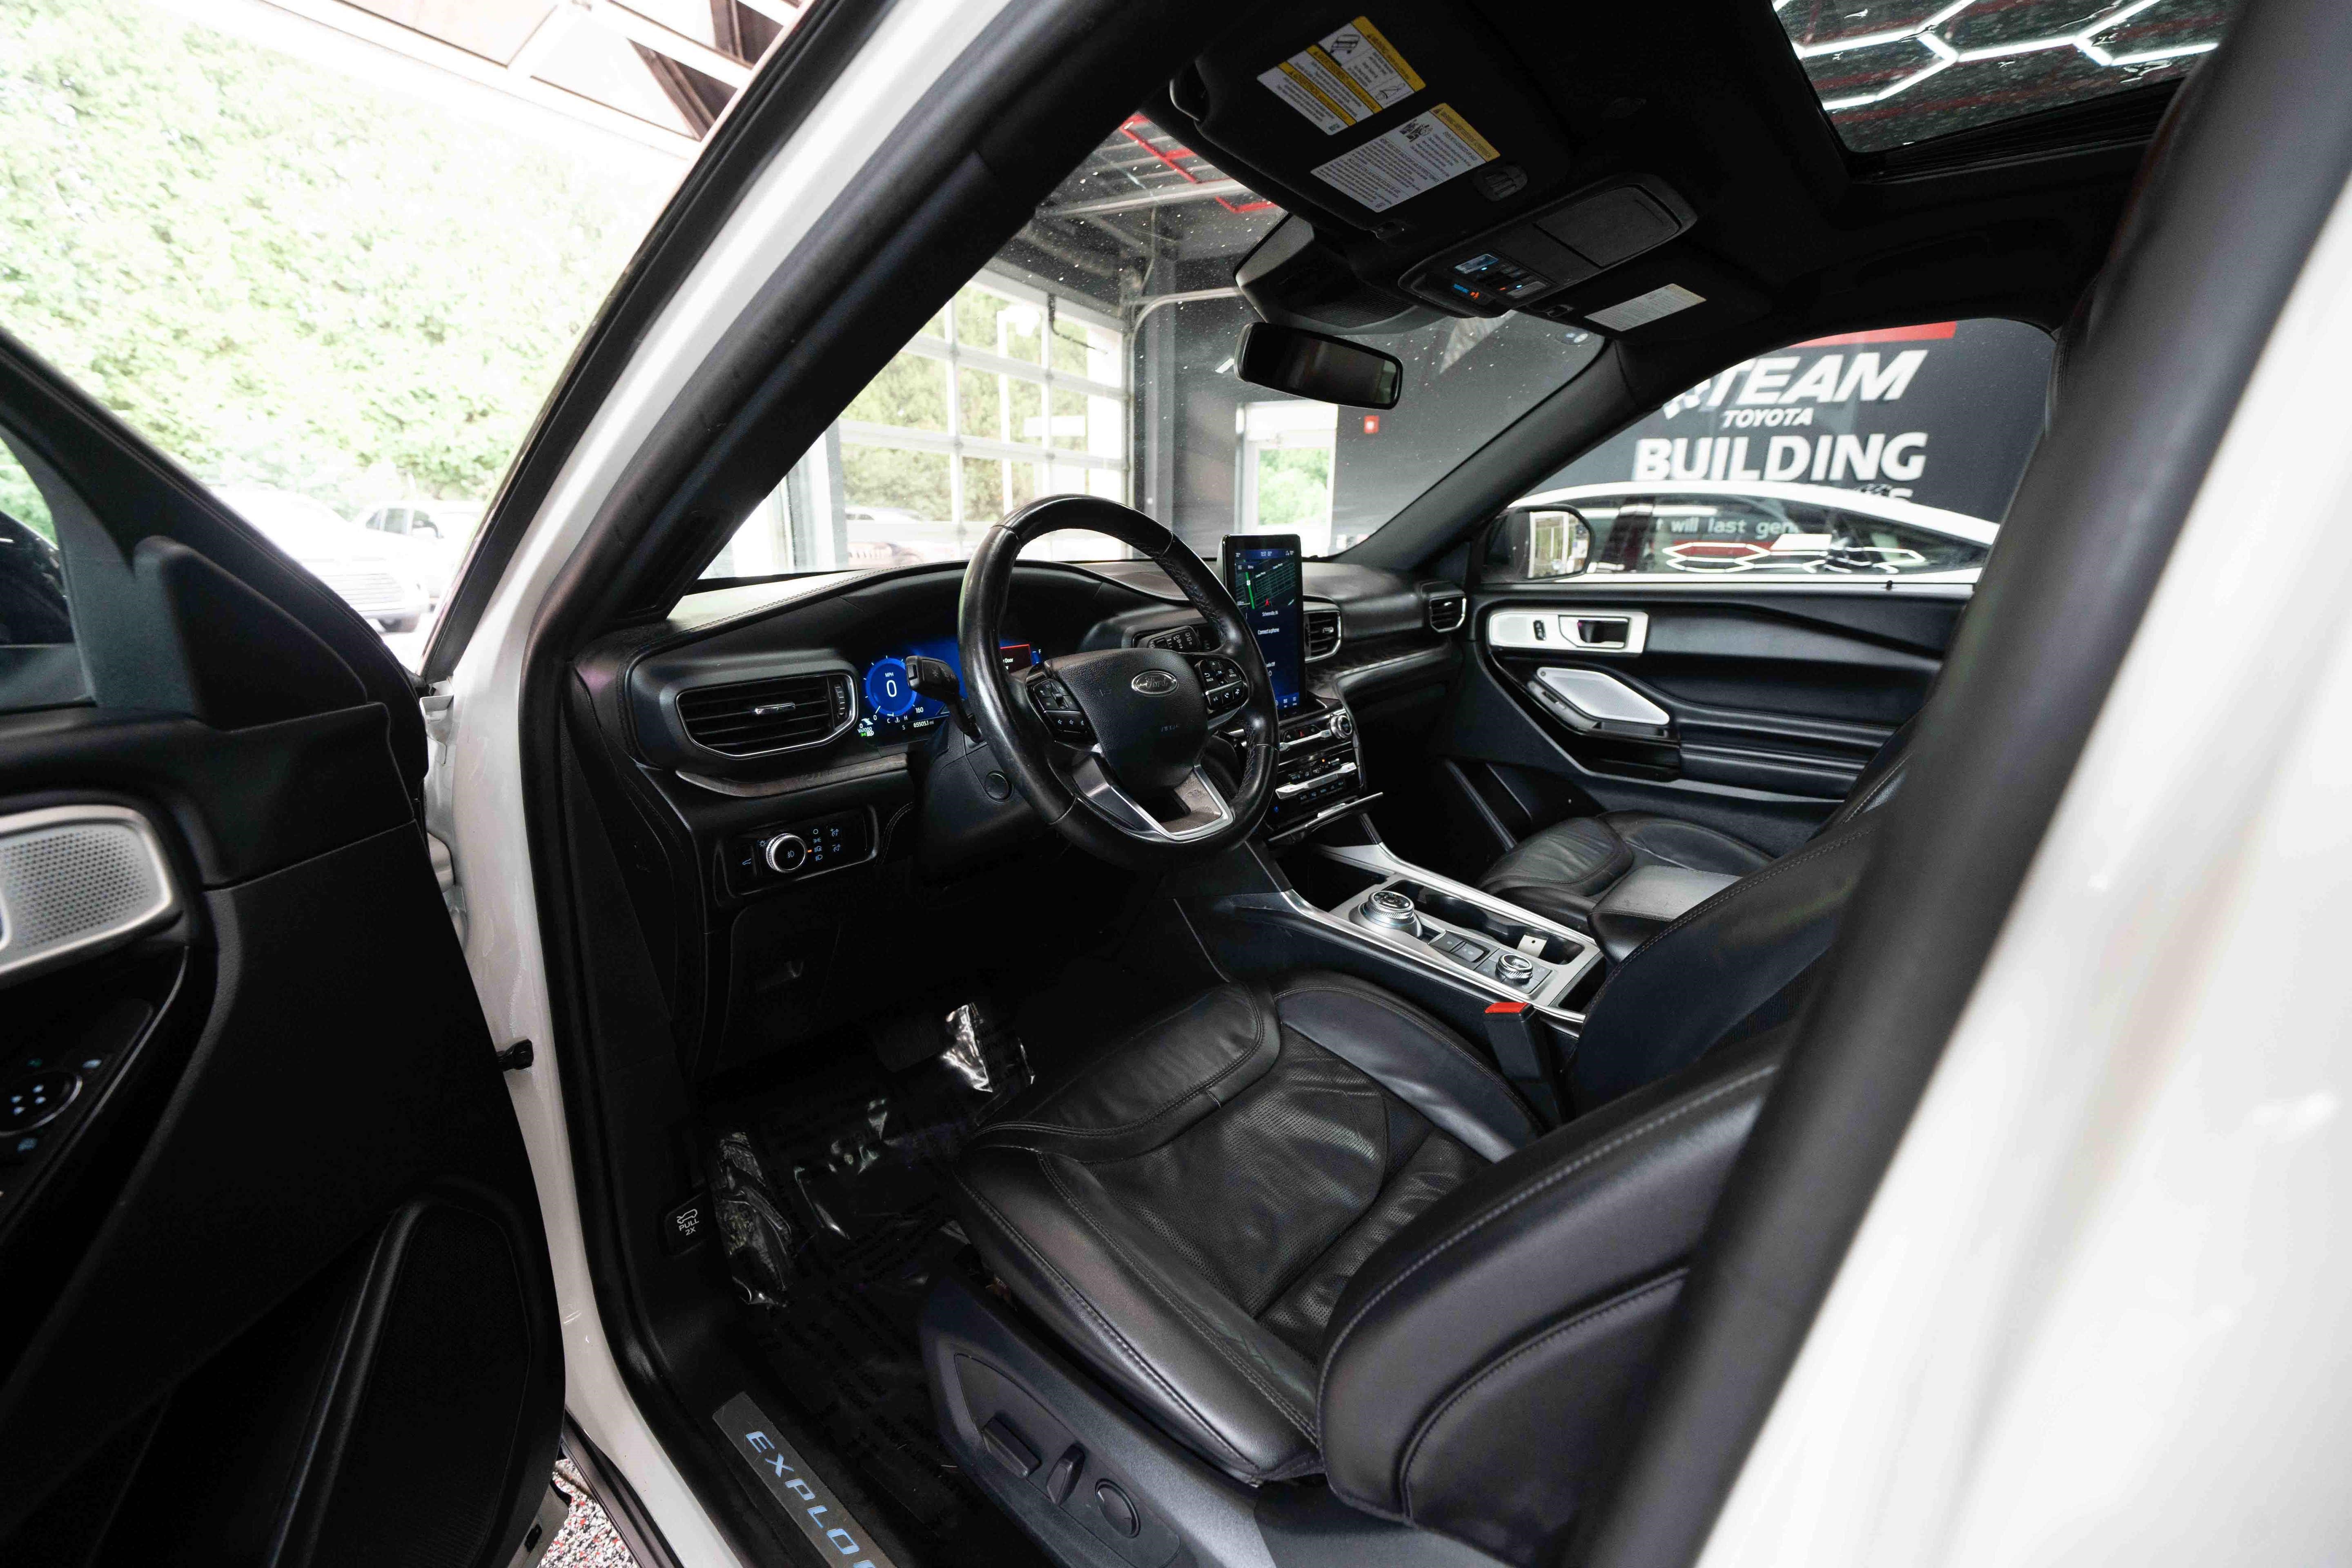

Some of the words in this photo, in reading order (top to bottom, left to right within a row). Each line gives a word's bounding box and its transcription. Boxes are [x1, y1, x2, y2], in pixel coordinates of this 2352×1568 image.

[1706, 350, 1927, 406] TEAM
[1722, 407, 1813, 428] TOYOTA
[1633, 432, 1927, 481] BUILDING
[1671, 517, 1699, 532] will
[1708, 517, 1747, 533] last
[1755, 521, 1799, 540] gen
[886, 679, 897, 697] 0
[1138, 675, 1168, 689] Ford
[679, 1218, 699, 1231] PULL
[686, 1227, 695, 1235] 2X
